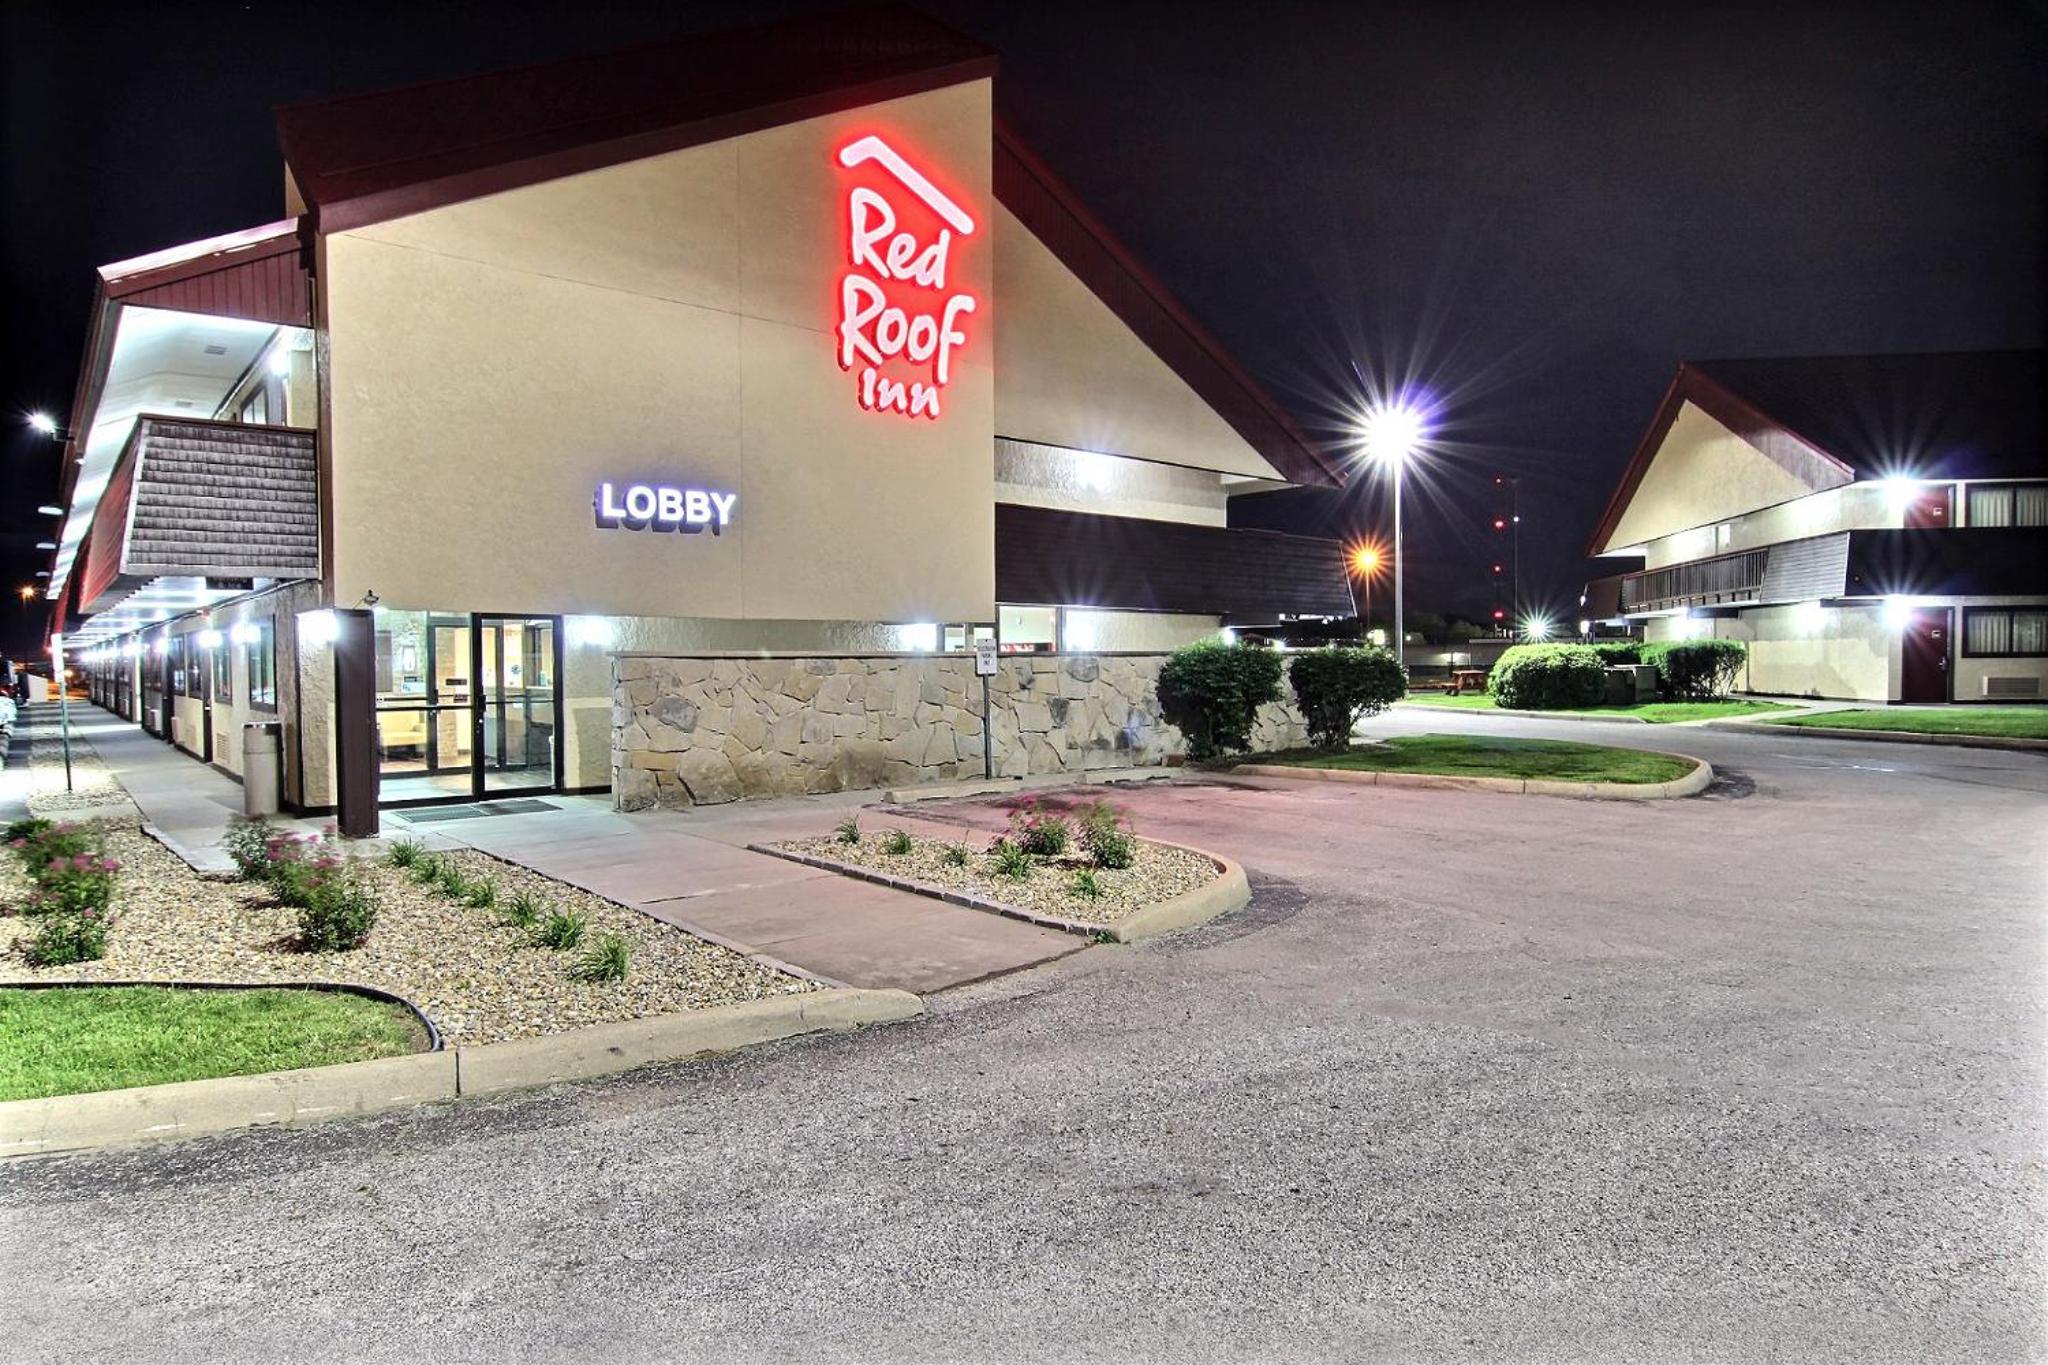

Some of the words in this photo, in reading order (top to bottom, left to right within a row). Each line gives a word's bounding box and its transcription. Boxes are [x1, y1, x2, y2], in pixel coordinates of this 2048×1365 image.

[849, 186, 950, 290] Red
[841, 273, 976, 384] Roof
[860, 367, 940, 417] Inn
[601, 482, 737, 526] LOBBY
